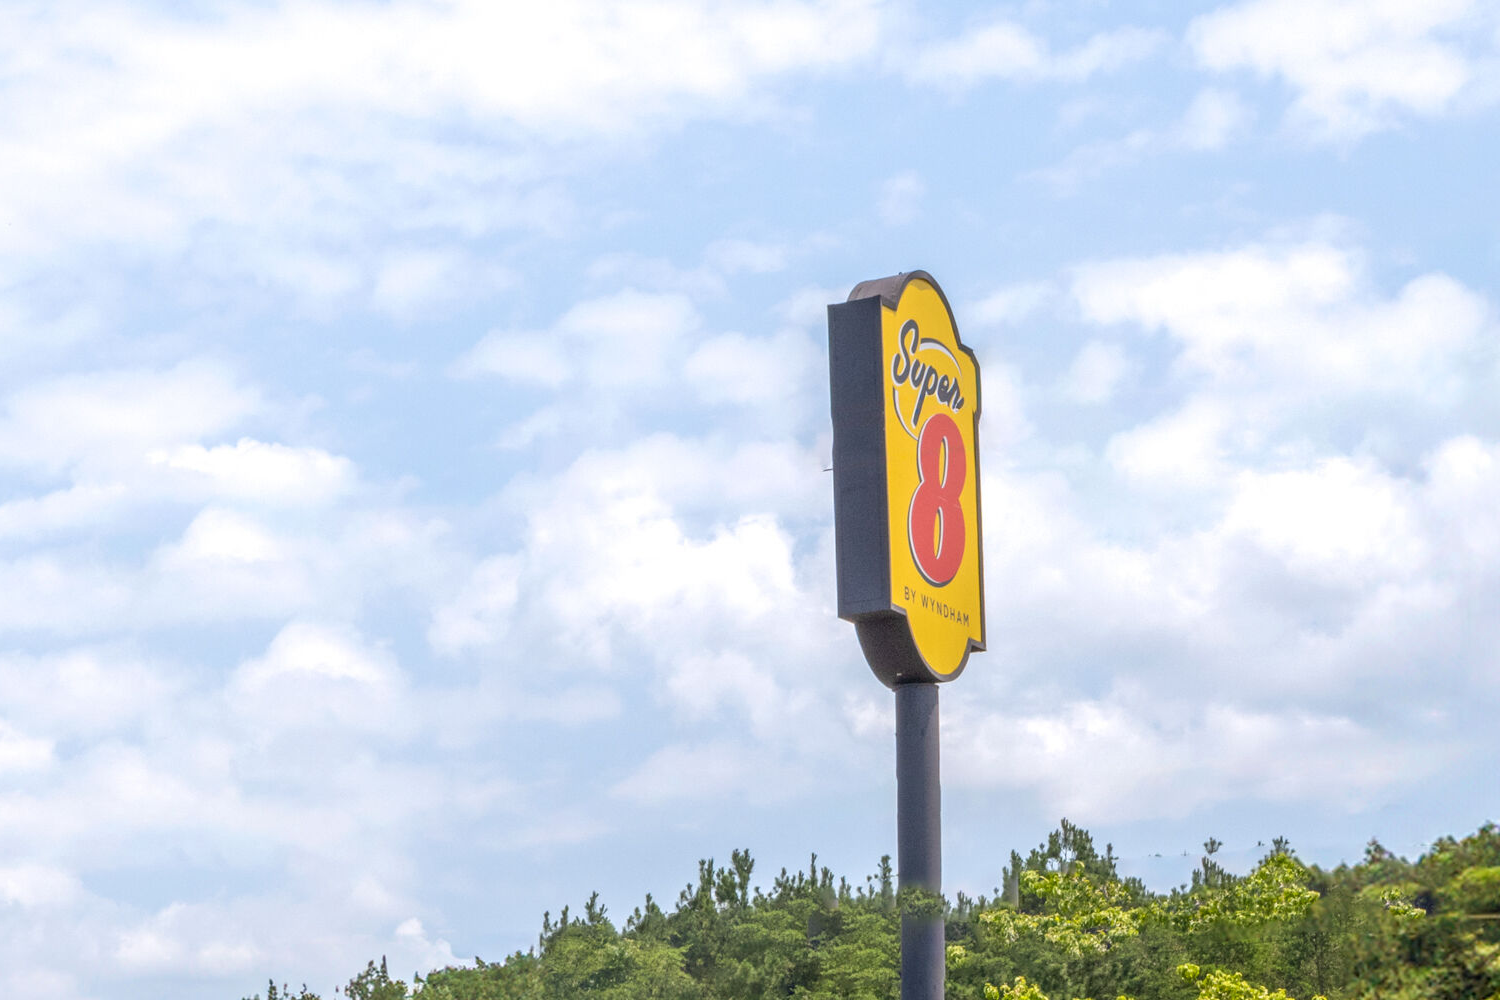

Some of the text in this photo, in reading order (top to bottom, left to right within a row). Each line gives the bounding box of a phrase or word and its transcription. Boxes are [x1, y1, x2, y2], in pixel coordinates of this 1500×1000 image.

[891, 319, 965, 429] Super
[908, 413, 967, 588] 8
[904, 586, 970, 627] BY WYNDHAM
